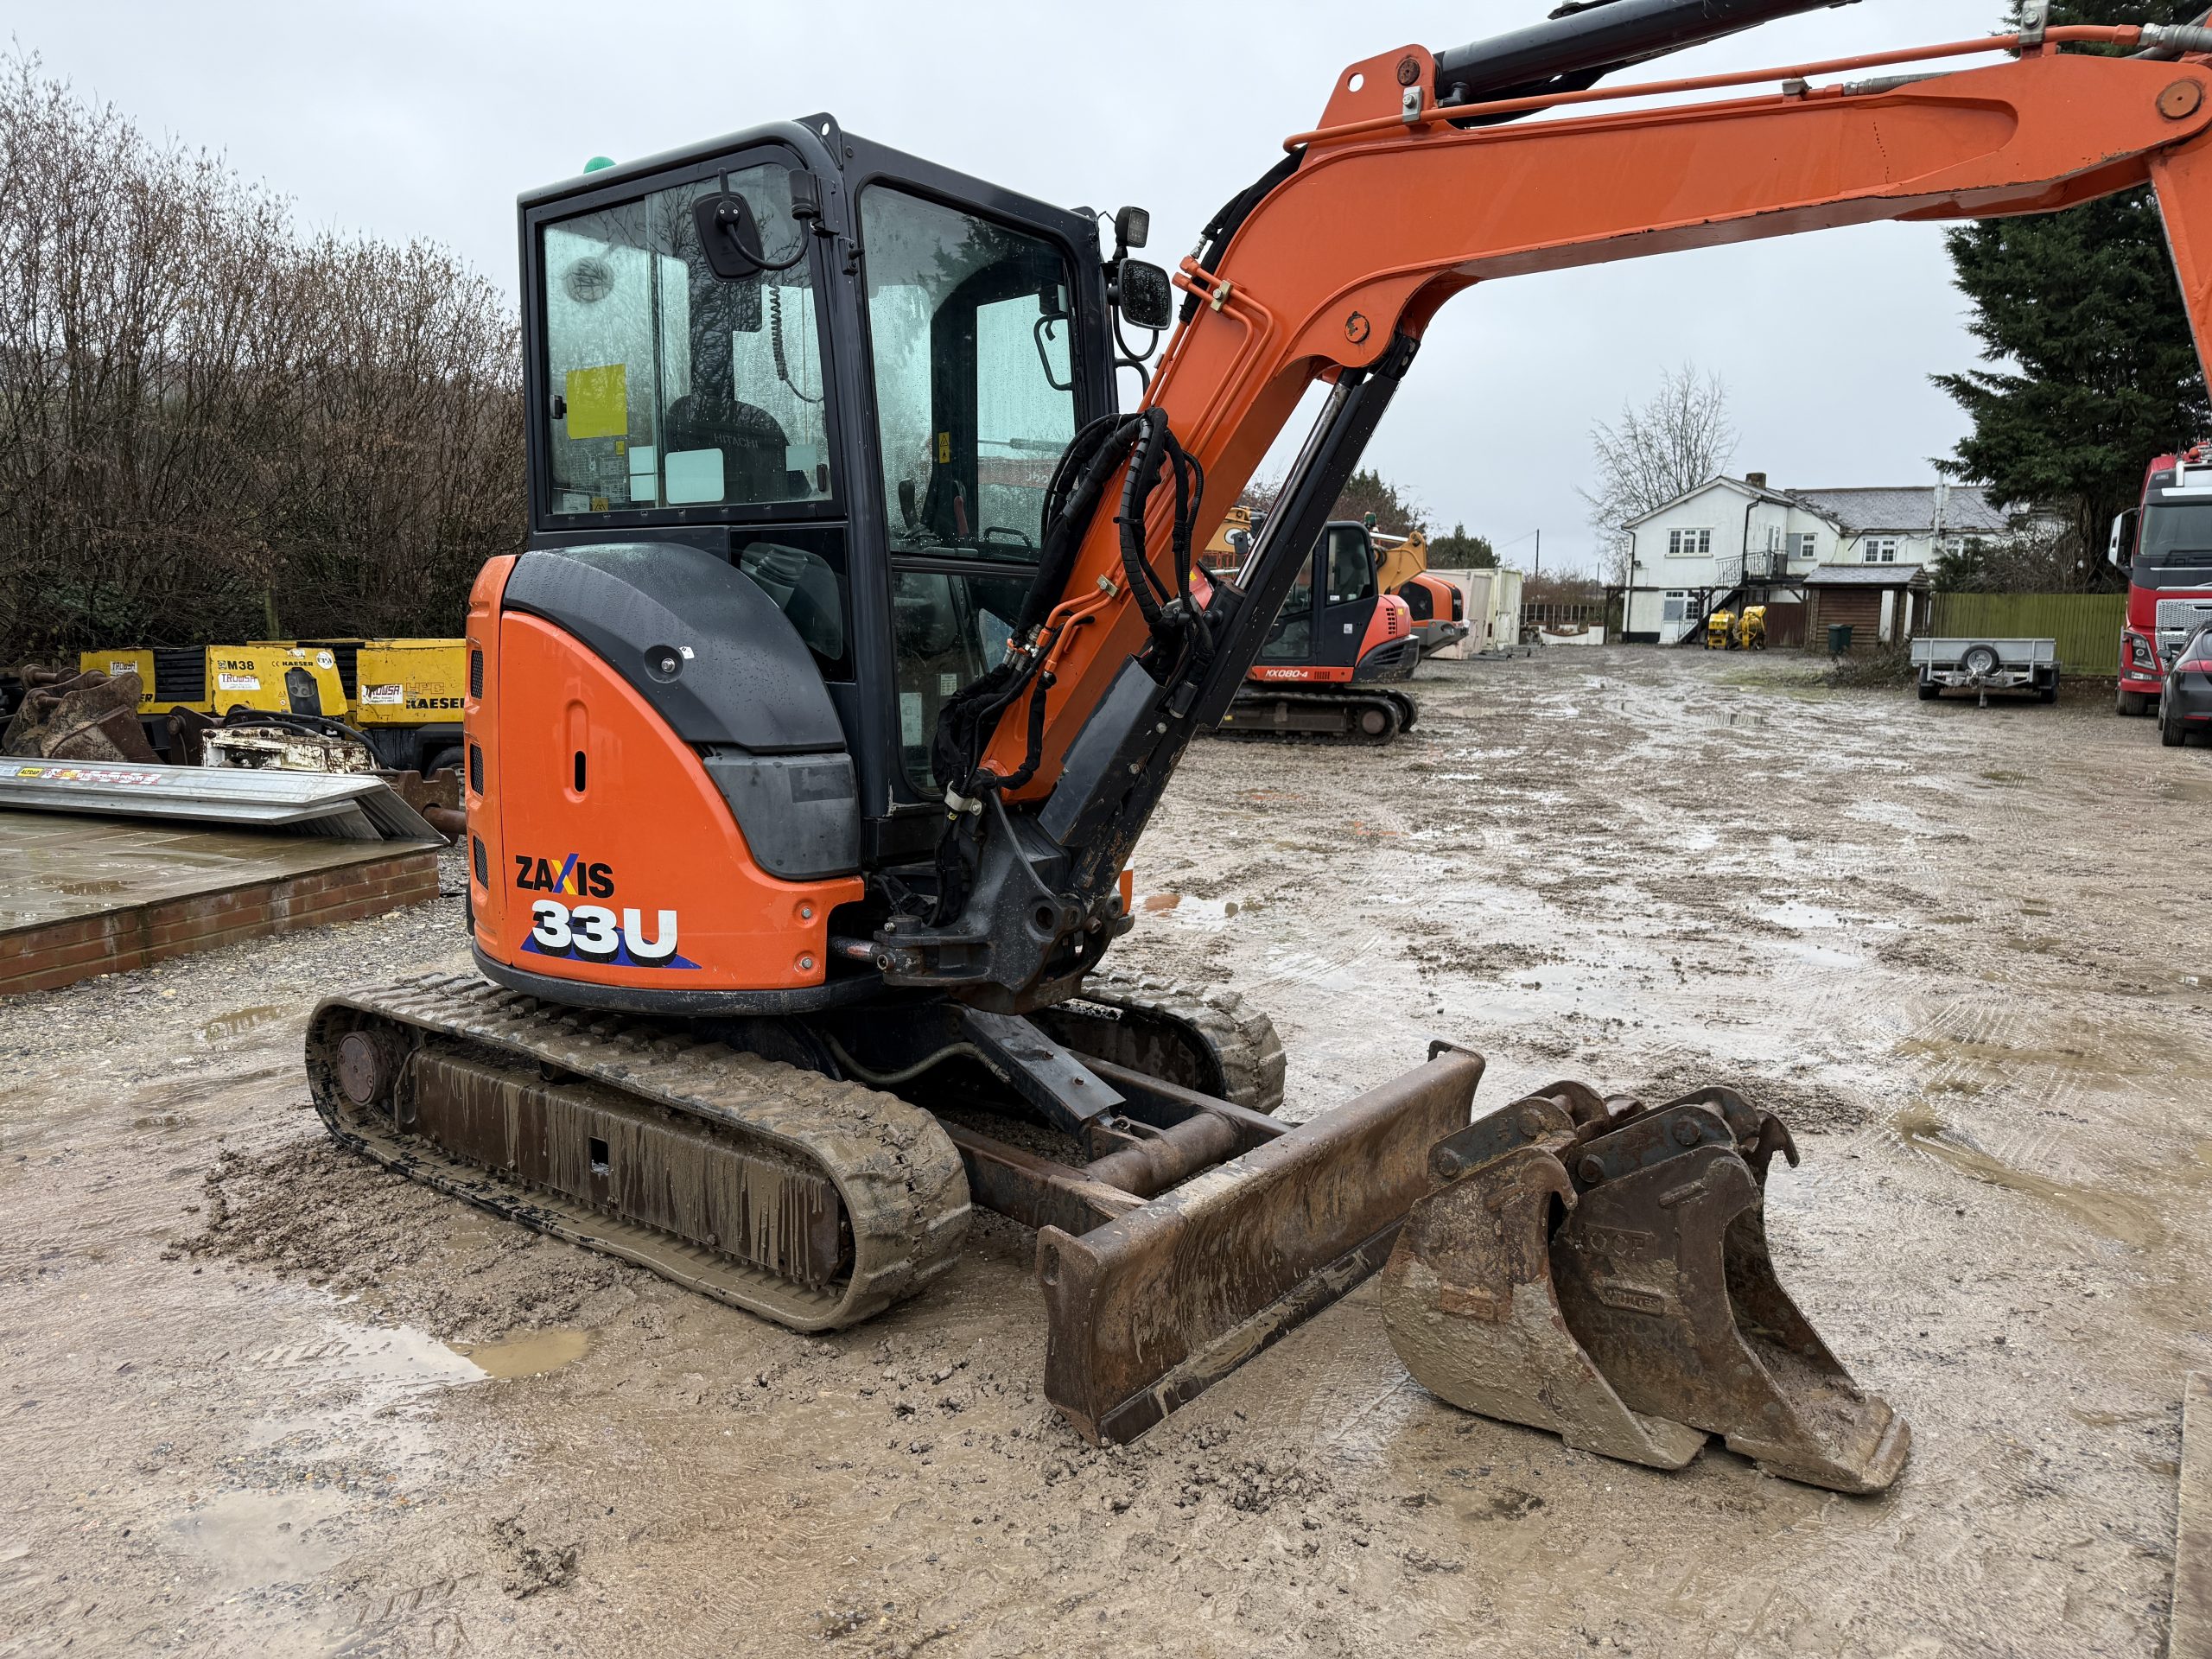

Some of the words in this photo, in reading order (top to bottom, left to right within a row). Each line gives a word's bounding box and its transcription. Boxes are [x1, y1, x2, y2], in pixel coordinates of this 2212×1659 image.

[714, 432, 759, 449] HITACHI
[227, 660, 255, 671] M38
[515, 853, 615, 899] ZAXIS
[531, 899, 678, 964] 33U
